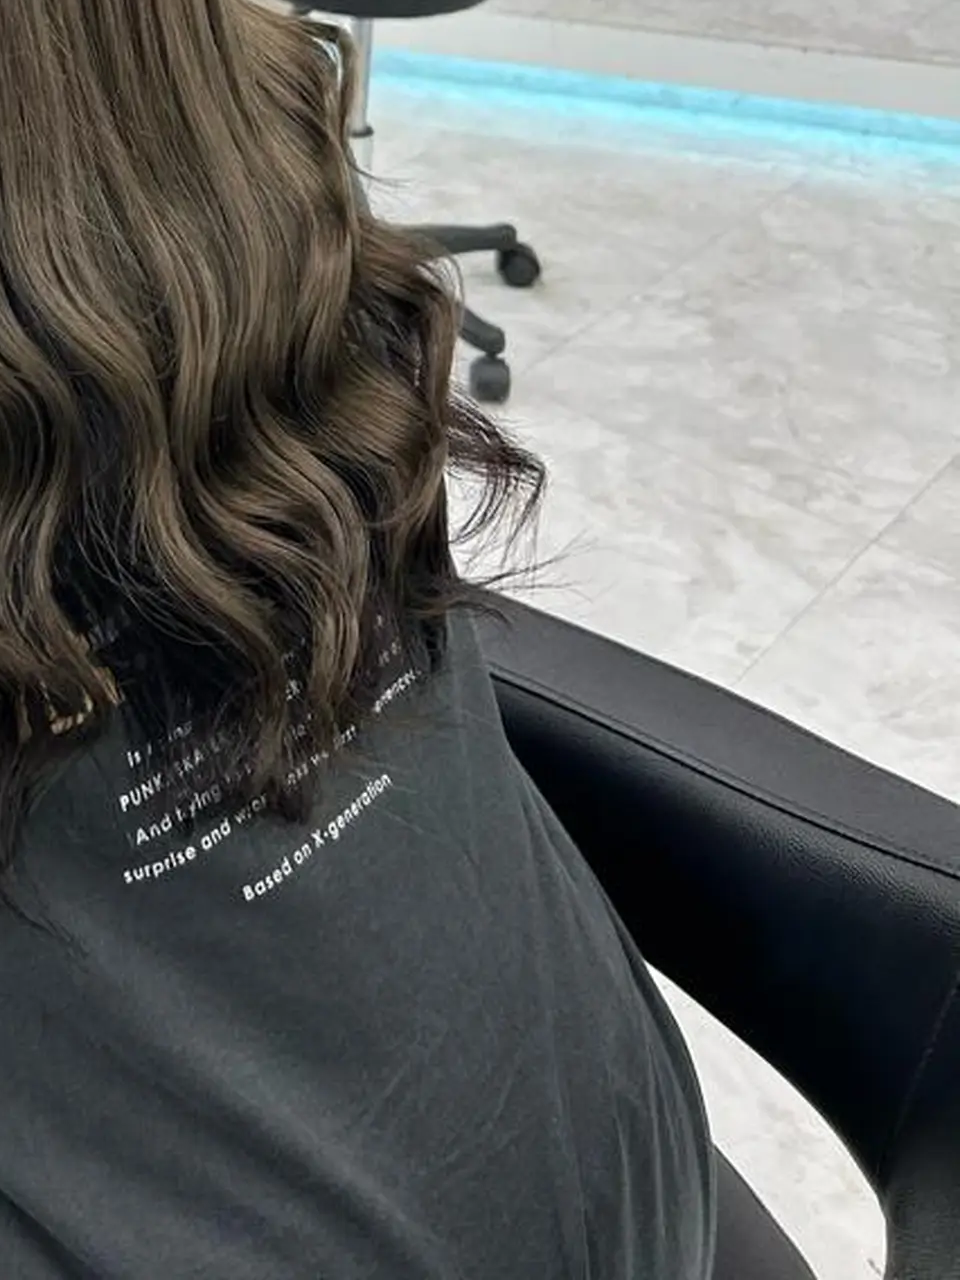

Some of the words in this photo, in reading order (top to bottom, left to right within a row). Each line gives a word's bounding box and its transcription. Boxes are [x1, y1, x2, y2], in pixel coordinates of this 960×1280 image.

[135, 814, 173, 846] And
[175, 784, 222, 822] tying
[123, 846, 197, 884] surprise
[201, 817, 232, 851] and
[241, 856, 294, 902] Based
[293, 842, 313, 865] on
